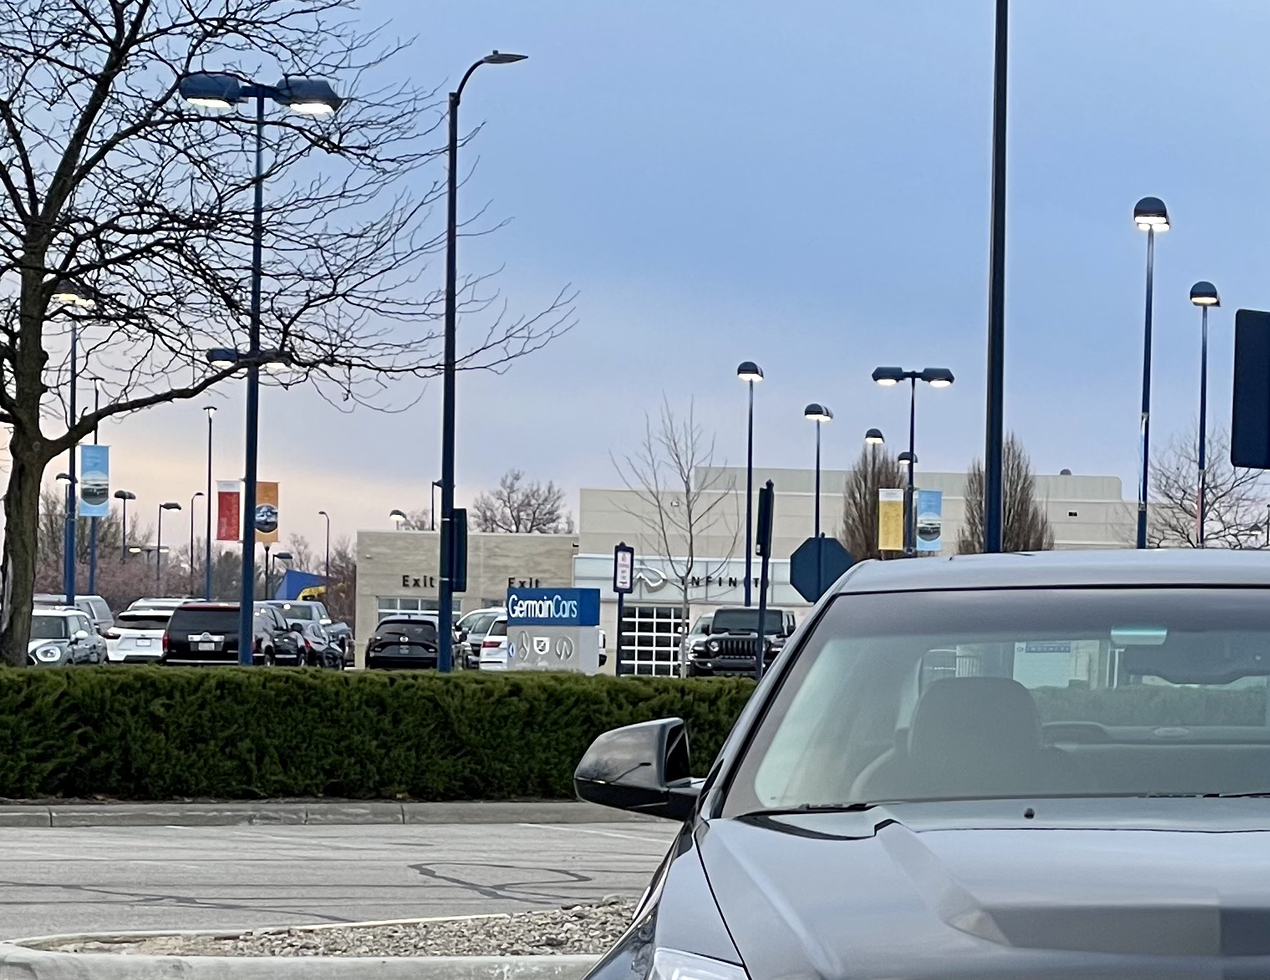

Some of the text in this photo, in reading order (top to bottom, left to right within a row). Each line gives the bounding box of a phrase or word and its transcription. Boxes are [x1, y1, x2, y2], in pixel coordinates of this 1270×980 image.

[402, 575, 435, 588] Exit
[509, 577, 540, 588] Exit
[509, 594, 578, 619] GermainCars
